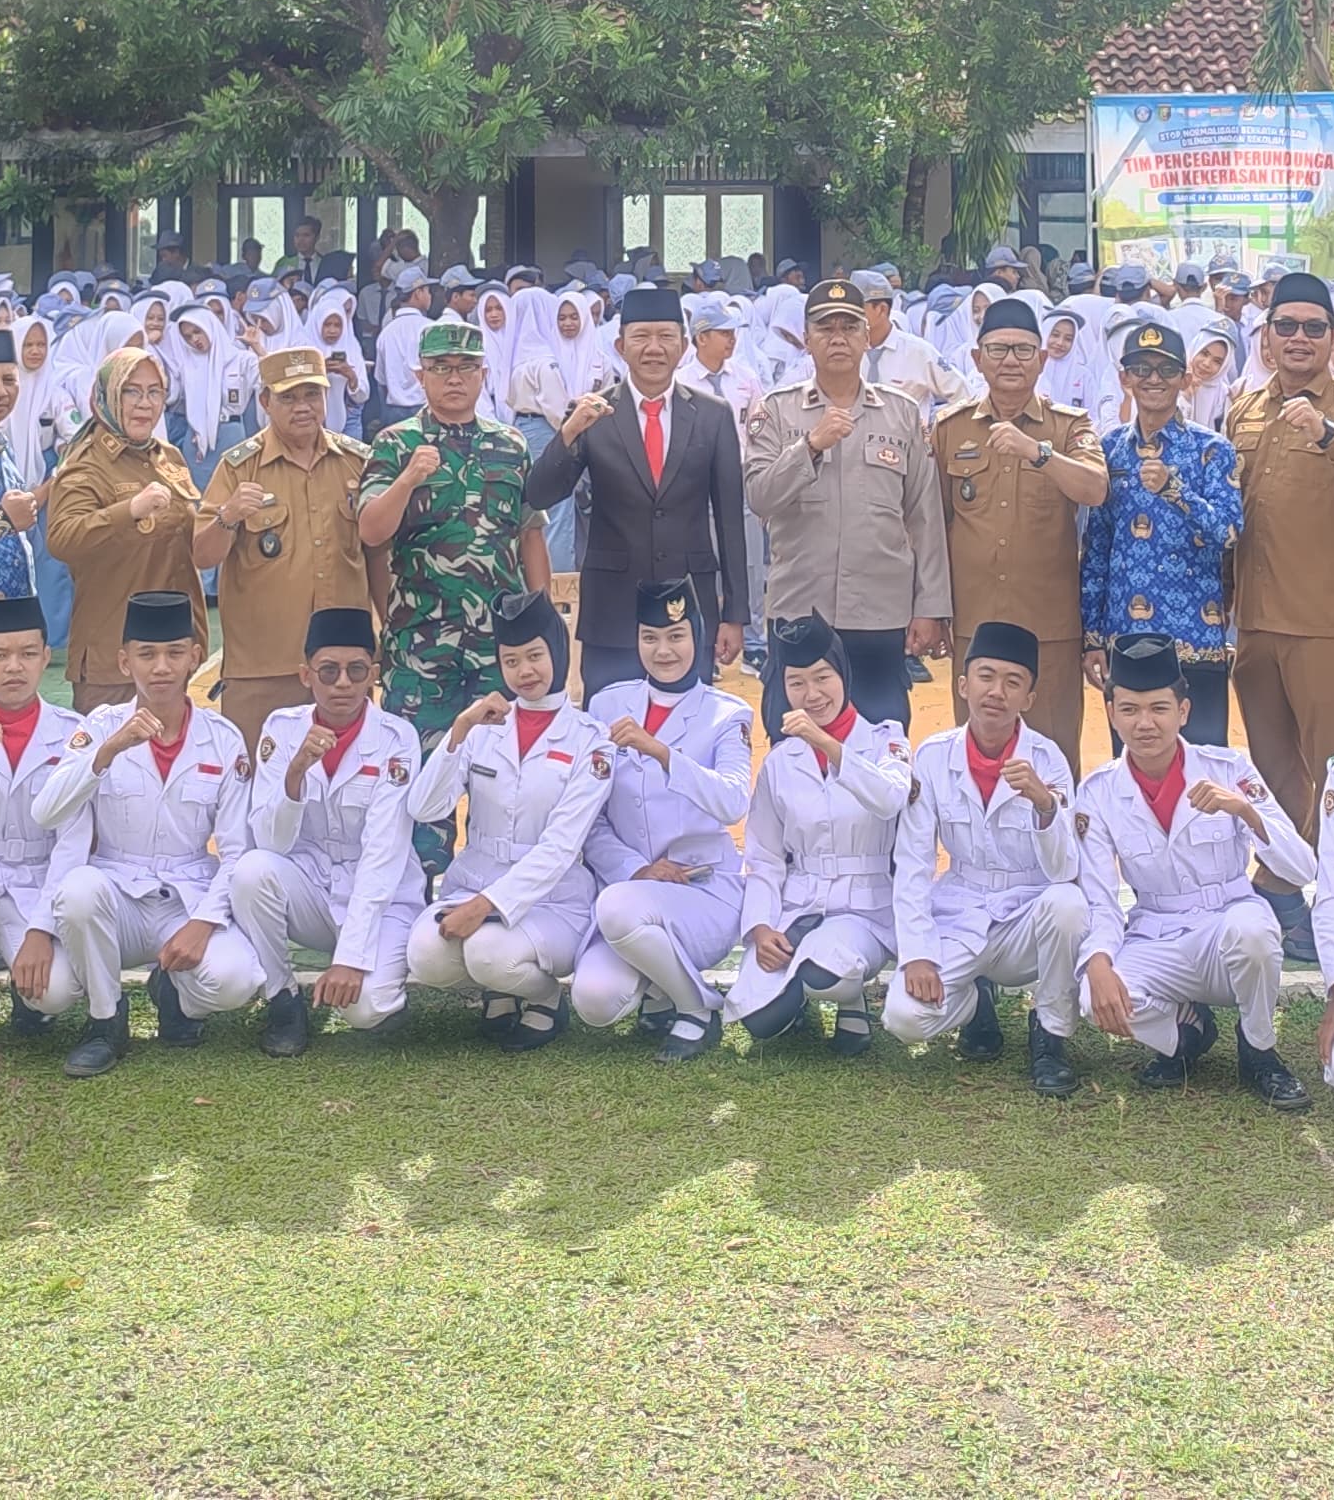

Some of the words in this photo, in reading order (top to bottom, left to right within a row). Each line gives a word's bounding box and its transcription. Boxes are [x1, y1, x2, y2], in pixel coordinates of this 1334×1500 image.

[1160, 131, 1180, 141] STOP
[1124, 156, 1152, 173] TIM
[1155, 151, 1231, 170] PENCEGAH
[1149, 171, 1180, 188] DAN
[1182, 169, 1267, 186] KEKERASAN
[868, 434, 907, 450] POLRI
